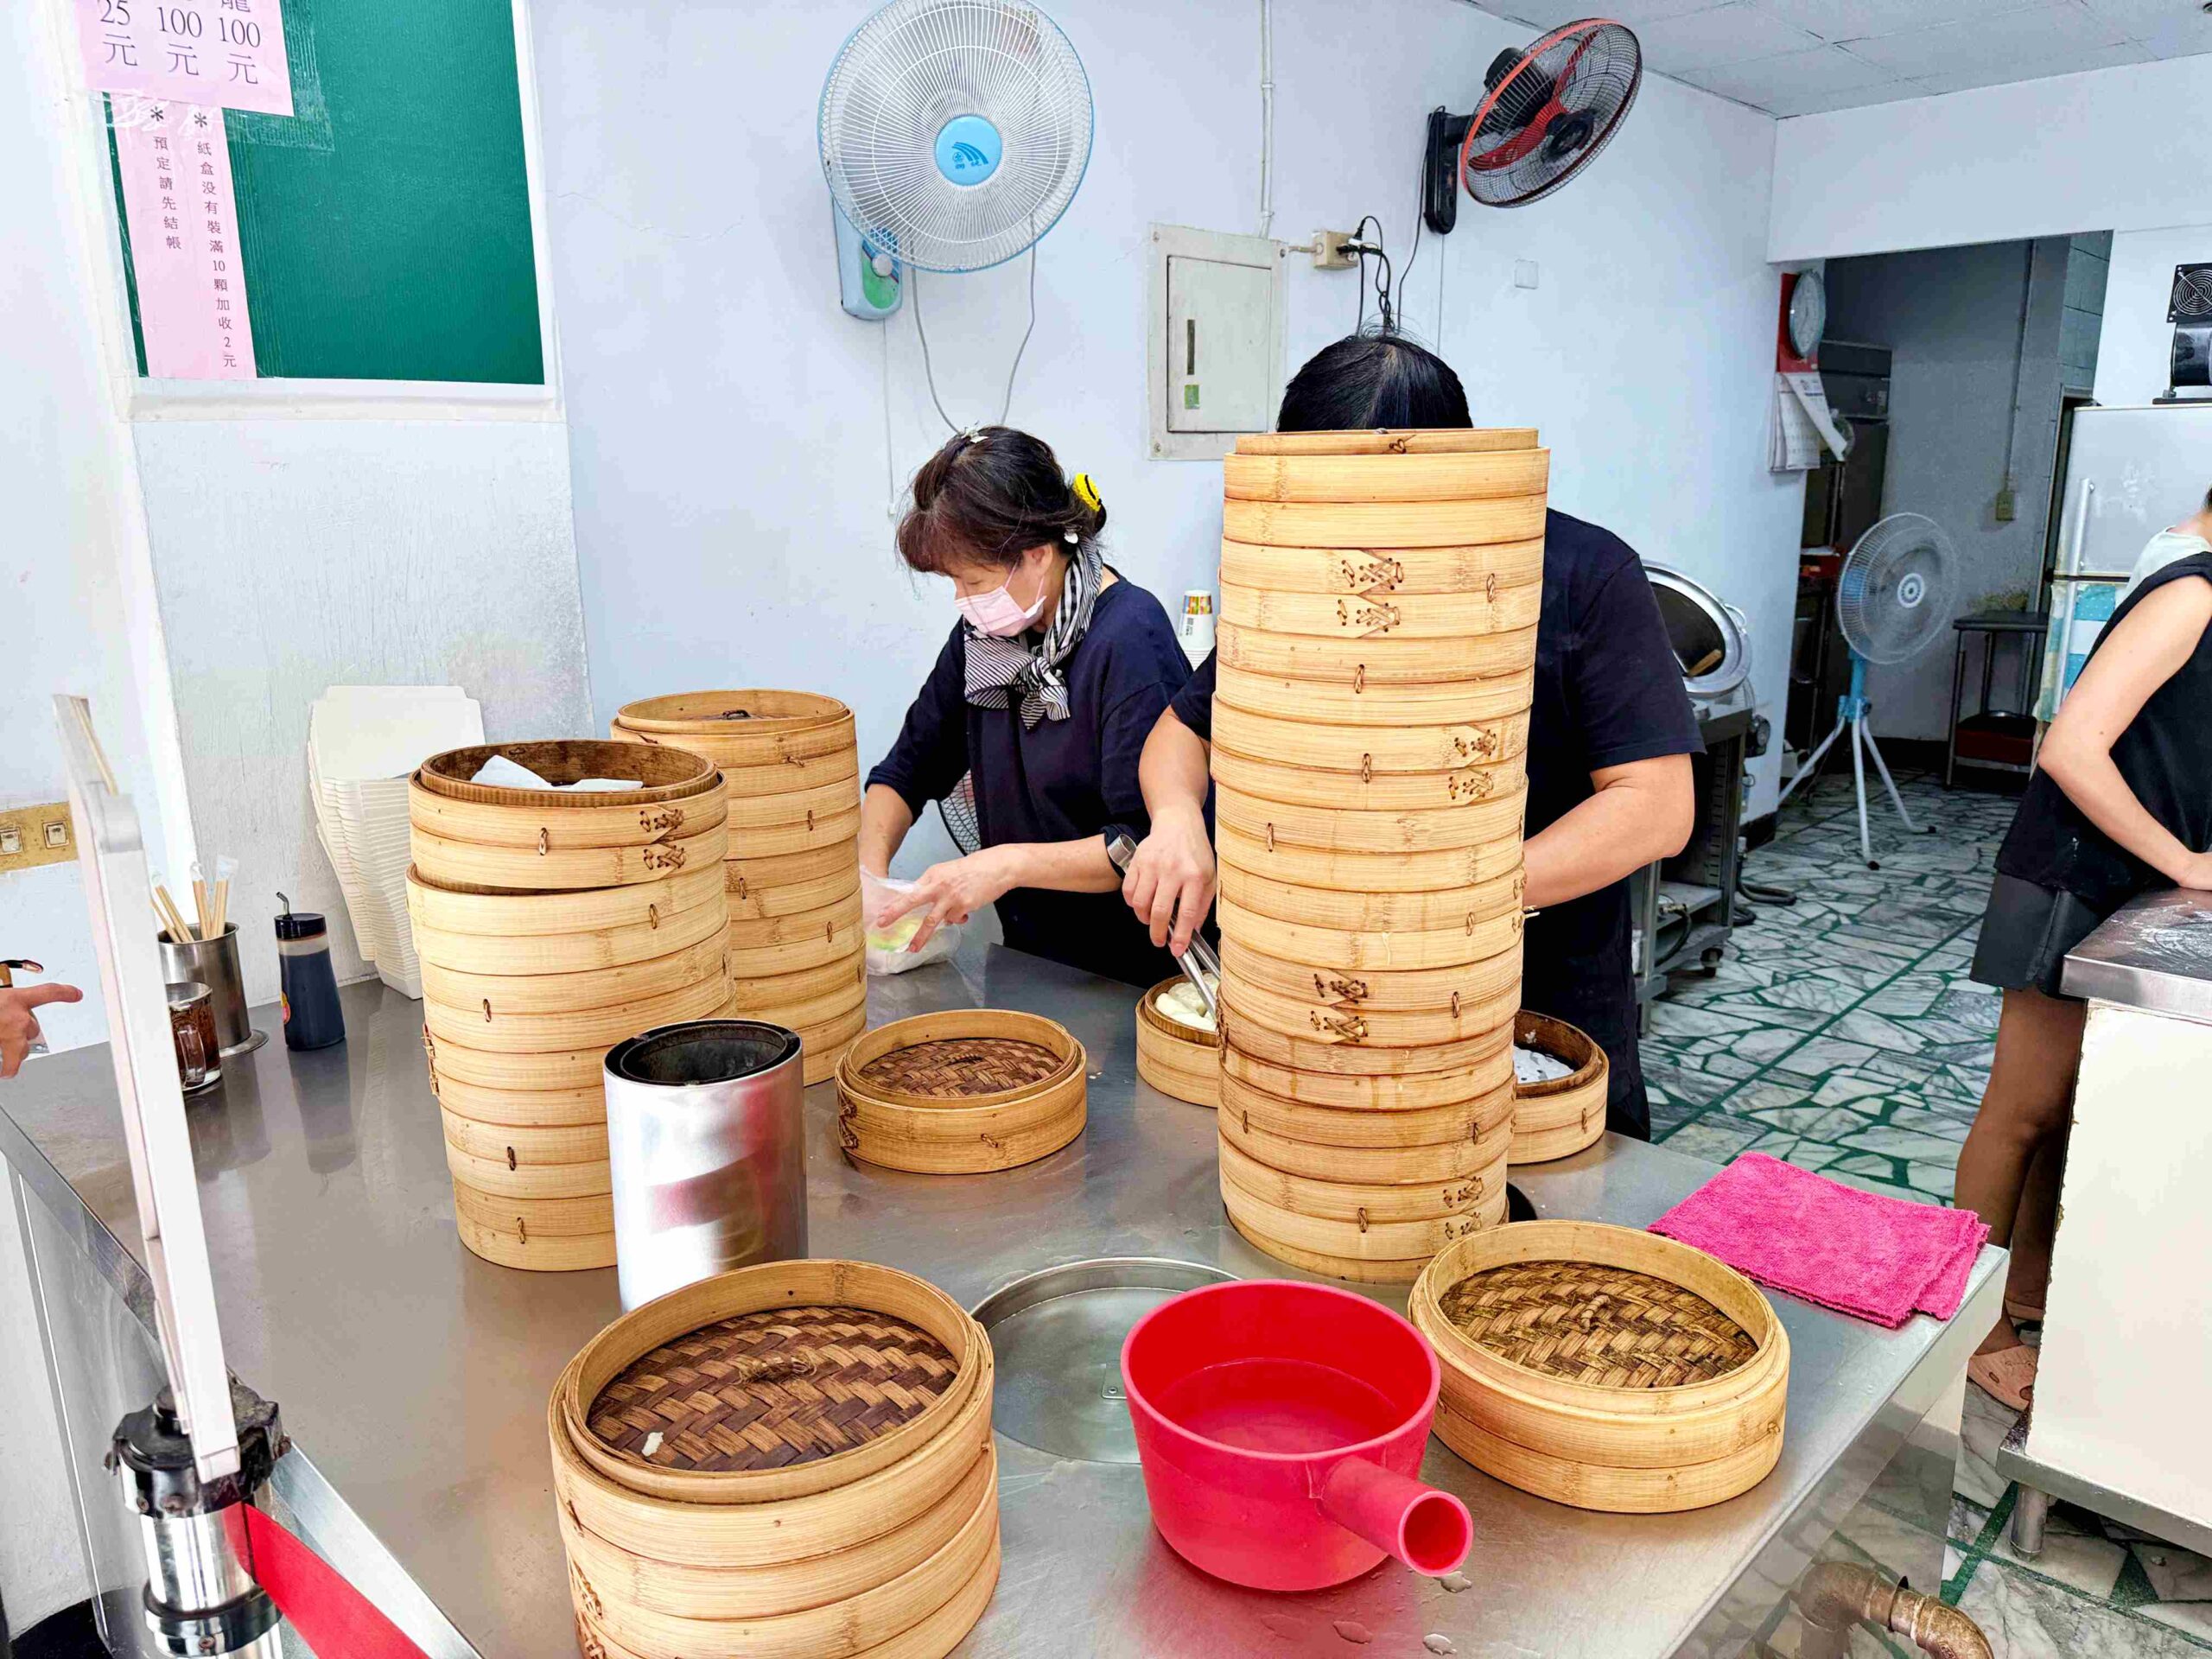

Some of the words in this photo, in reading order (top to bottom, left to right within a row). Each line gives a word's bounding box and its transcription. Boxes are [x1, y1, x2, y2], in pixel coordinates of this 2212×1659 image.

[153, 136, 181, 250] 預定請先結帳
